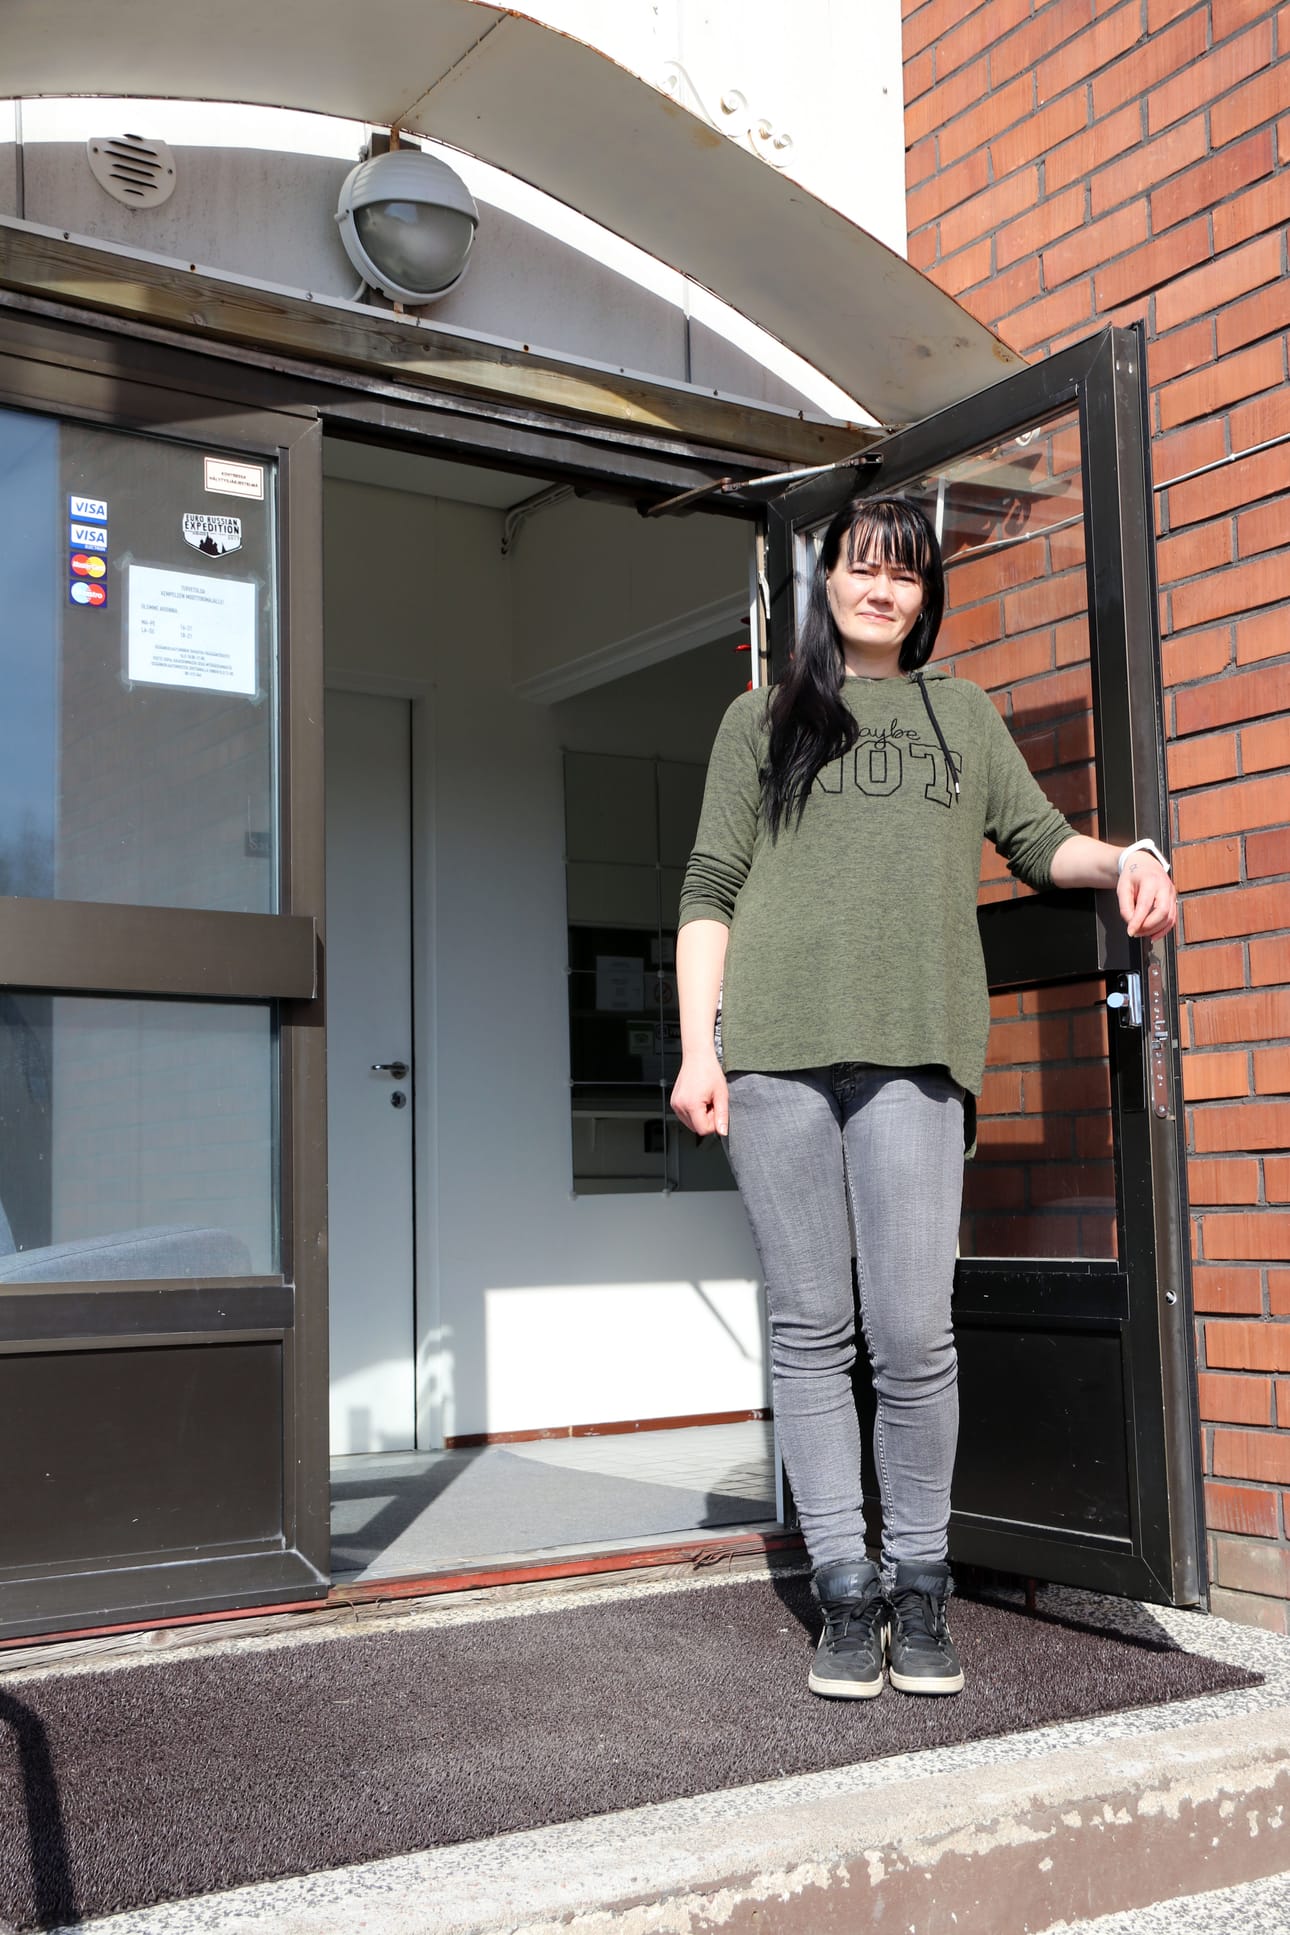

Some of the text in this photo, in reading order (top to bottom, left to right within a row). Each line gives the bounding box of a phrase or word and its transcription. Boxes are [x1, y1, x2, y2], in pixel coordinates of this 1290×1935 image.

[76, 502, 105, 516] VISA
[185, 520, 240, 535] EXPEDITION
[186, 514, 238, 526] EURO RUSSIAN
[76, 529, 105, 544] VISA
[858, 718, 921, 750] aybe
